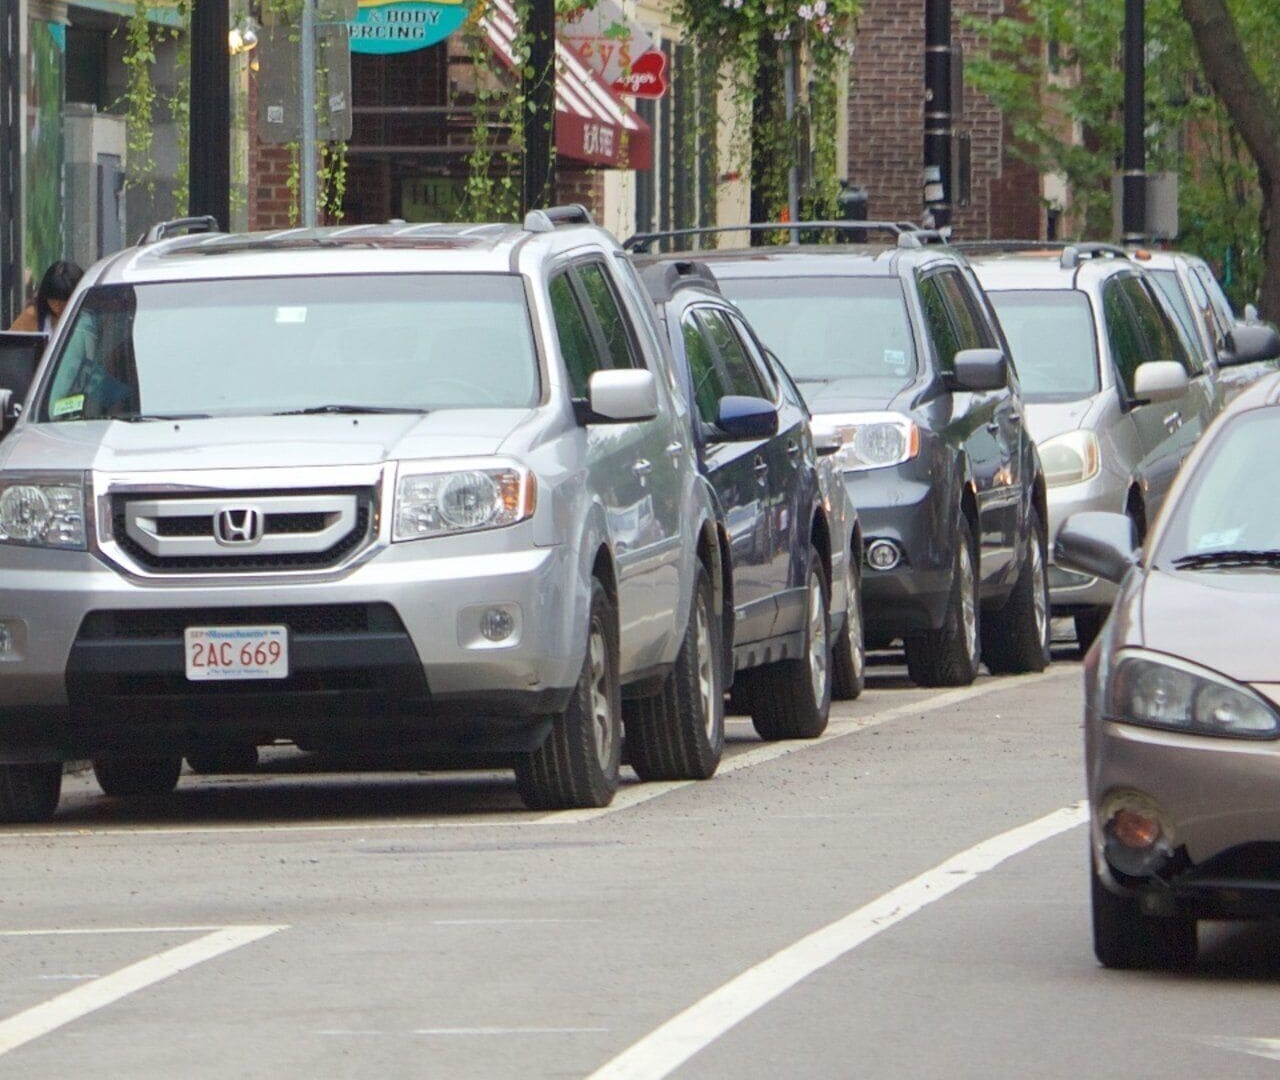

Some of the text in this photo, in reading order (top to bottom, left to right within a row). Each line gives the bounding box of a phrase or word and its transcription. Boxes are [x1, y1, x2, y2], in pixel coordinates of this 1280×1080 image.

[387, 10, 440, 23] BODY
[349, 25, 425, 38] ERCING
[192, 640, 281, 667] 2AC 669
